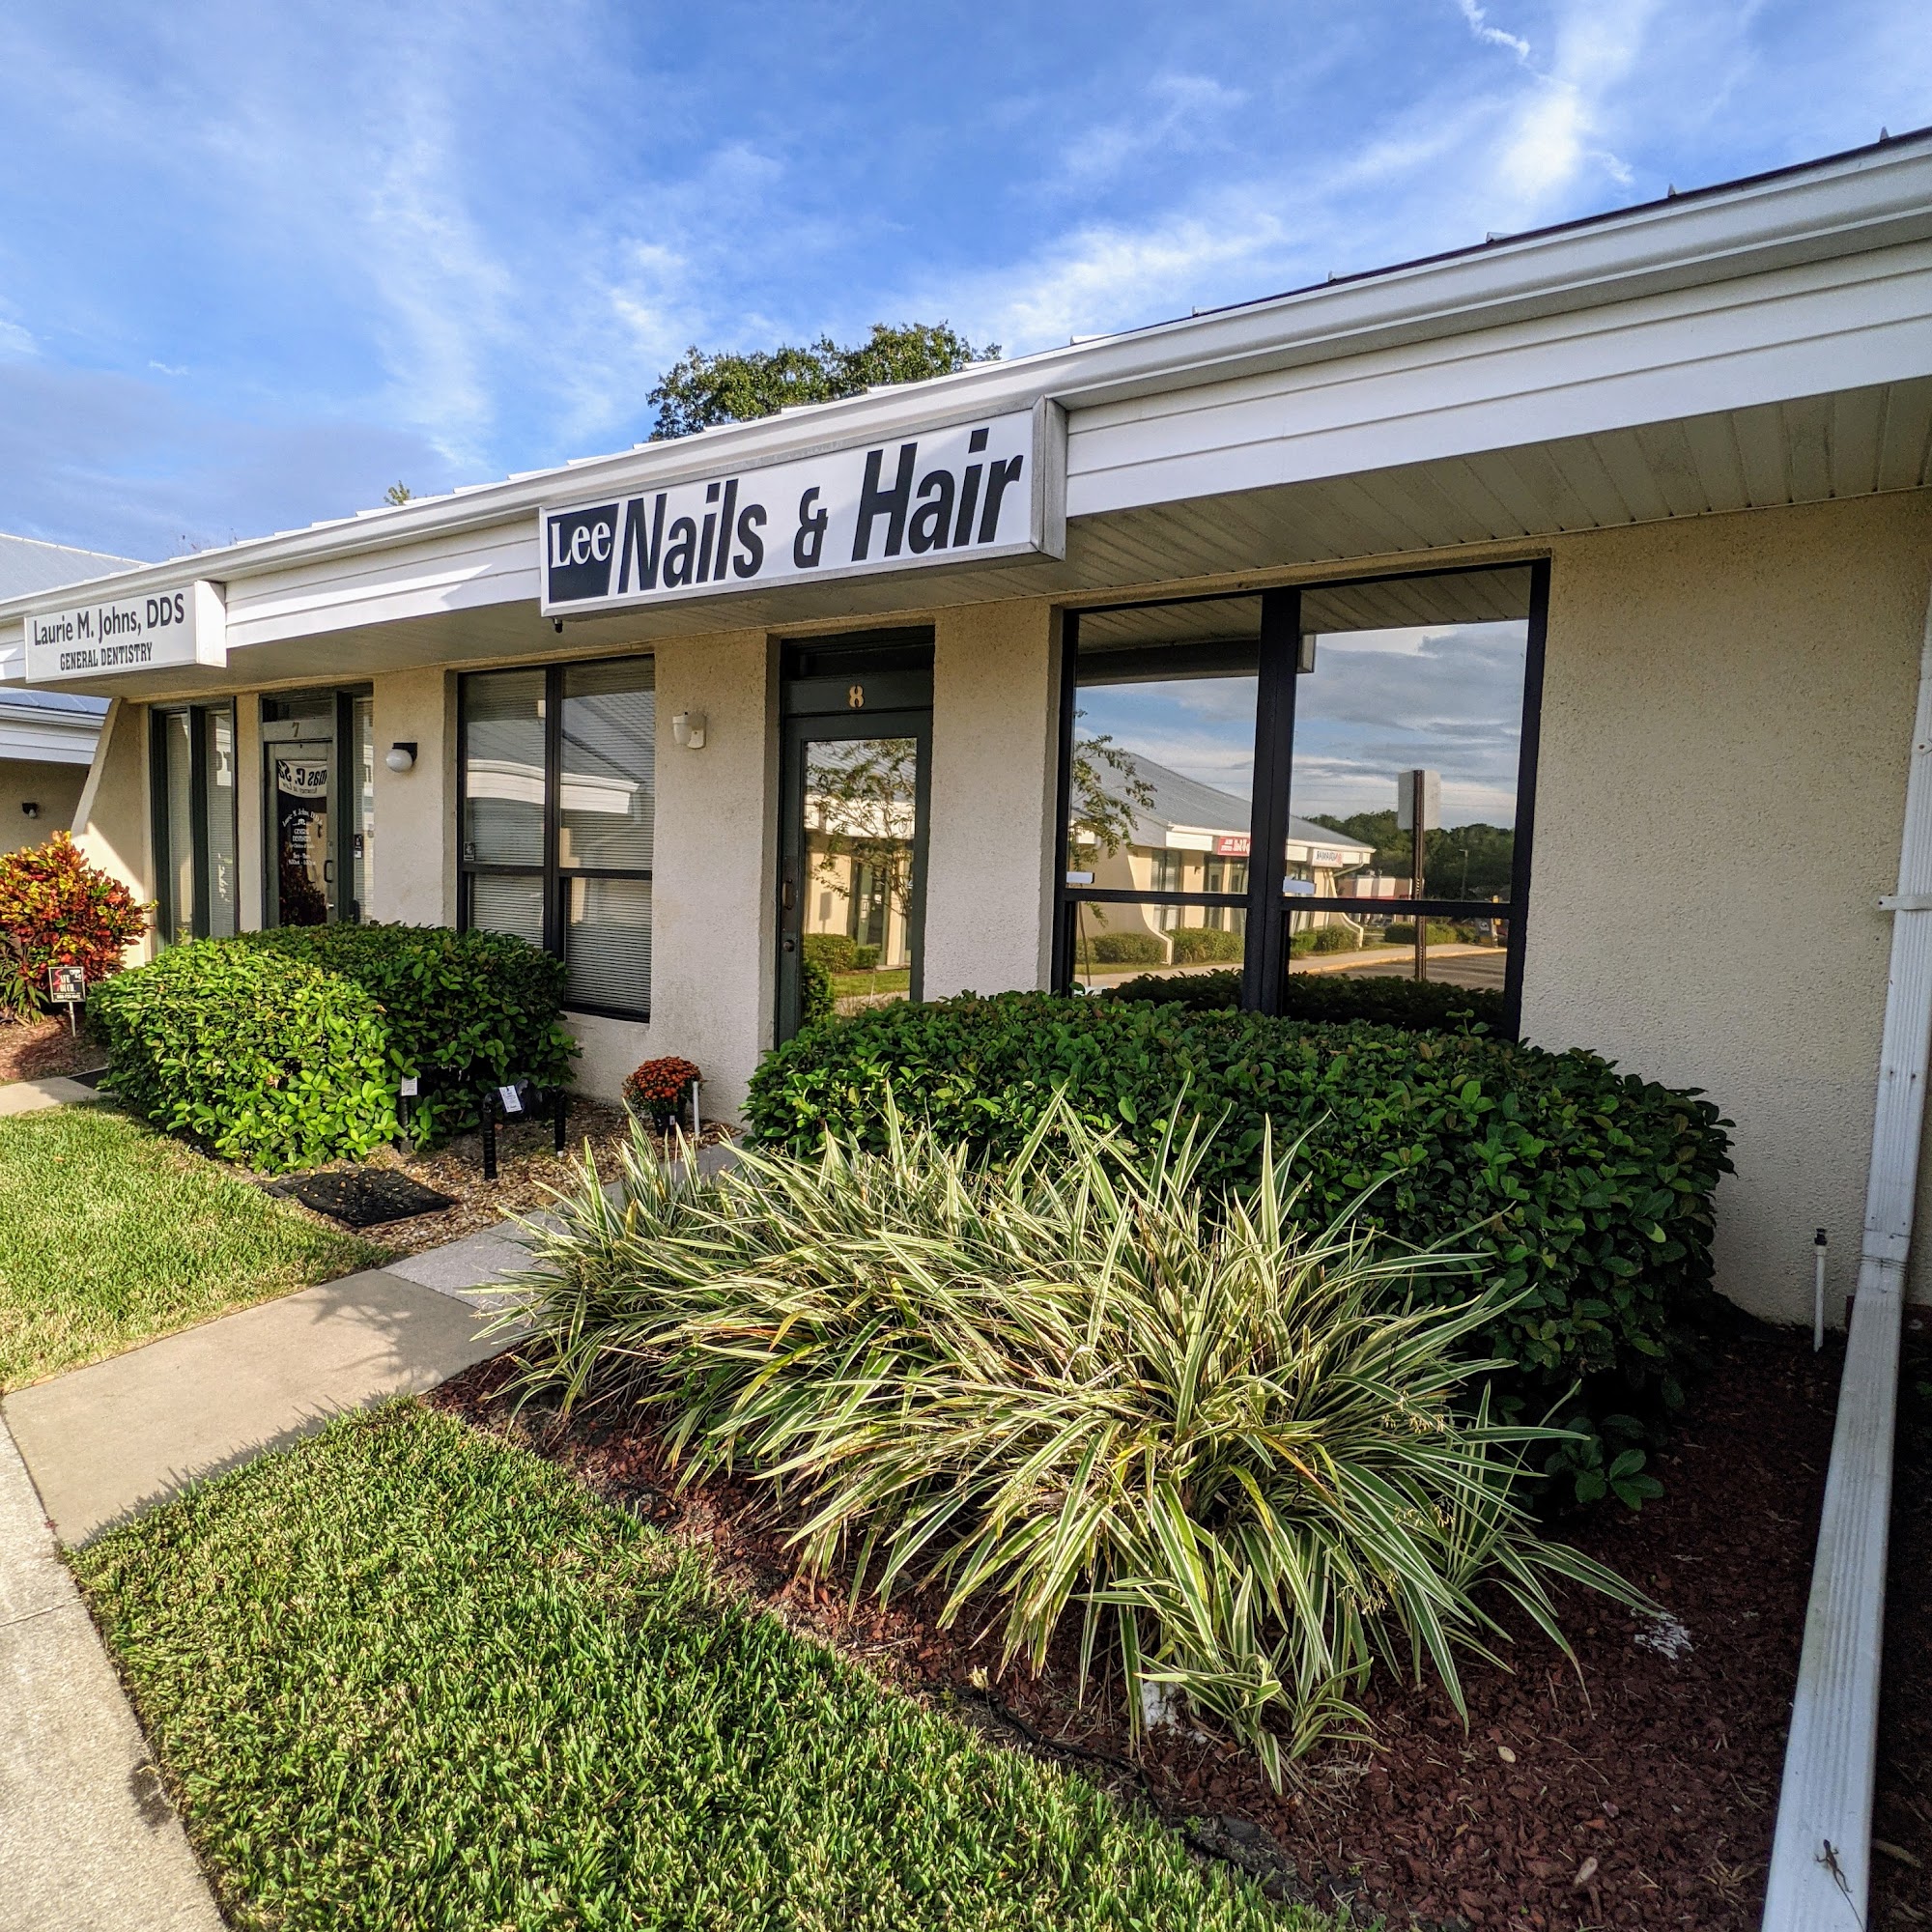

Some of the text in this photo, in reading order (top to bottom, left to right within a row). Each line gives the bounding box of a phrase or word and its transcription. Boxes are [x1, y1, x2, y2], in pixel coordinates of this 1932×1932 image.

[551, 428, 1023, 594] Lee Nails & Hair
[34, 593, 185, 646] Laurie M. Johns, DDS
[60, 641, 153, 671] GENERAL DENTISTRY
[849, 685, 865, 708] 8
[292, 722, 299, 737] 7
